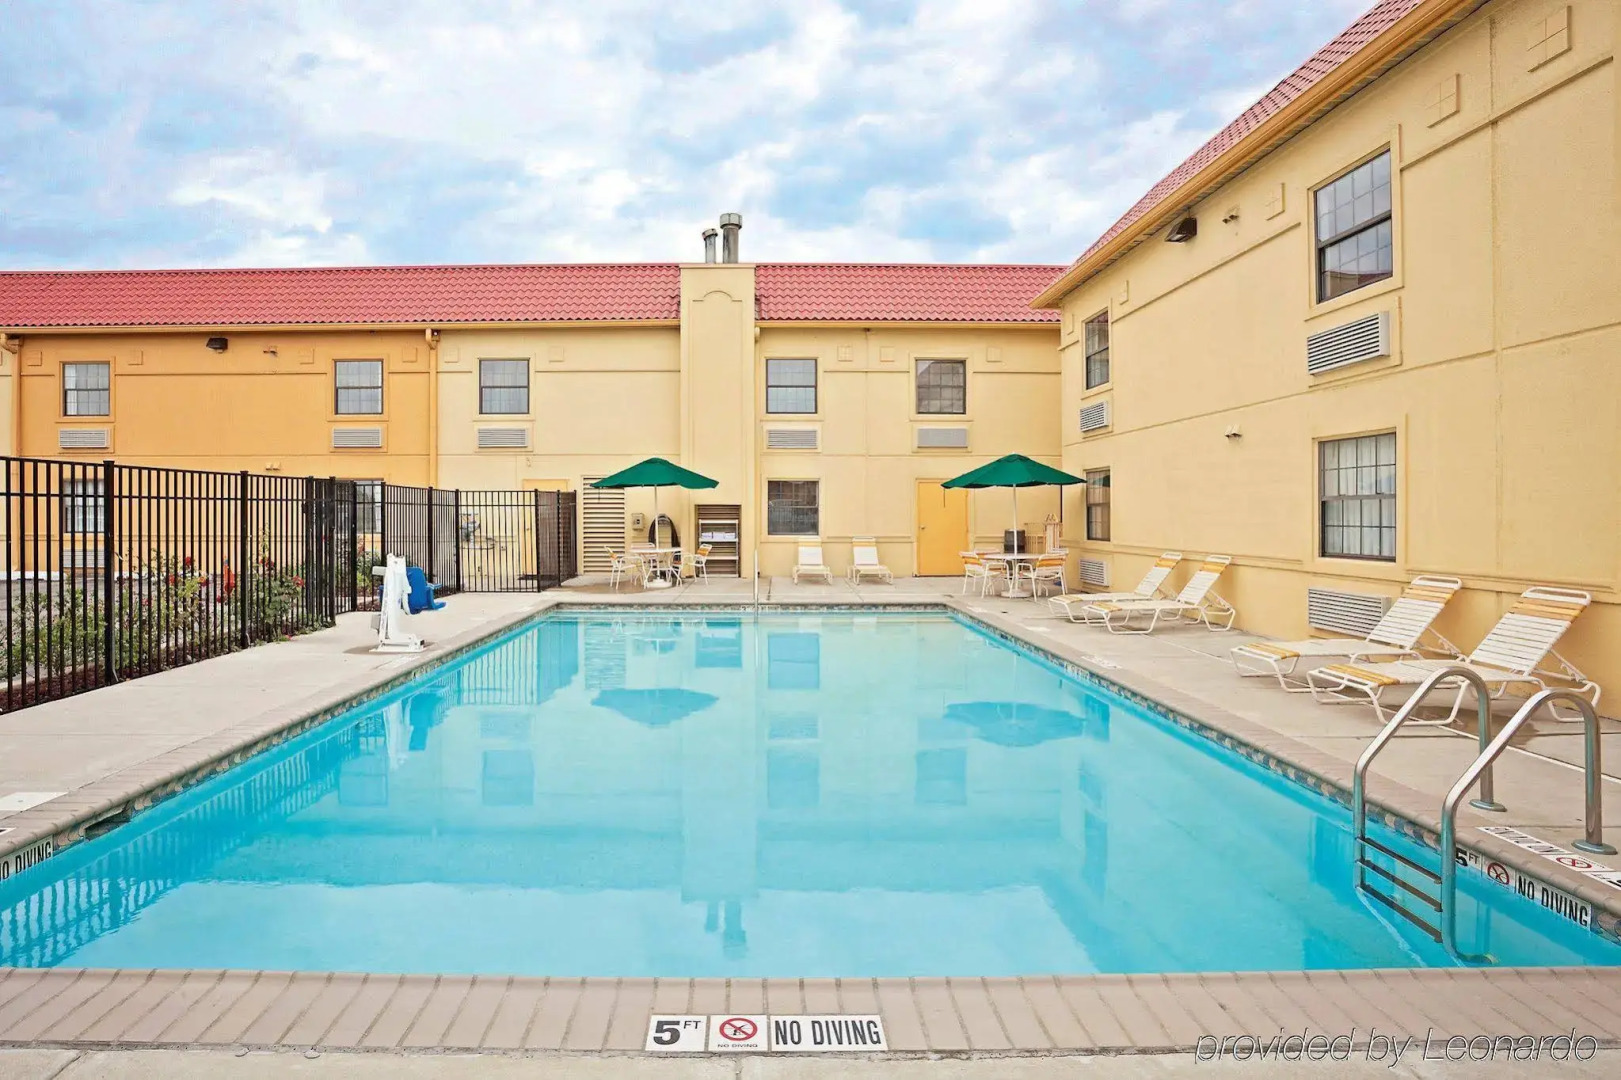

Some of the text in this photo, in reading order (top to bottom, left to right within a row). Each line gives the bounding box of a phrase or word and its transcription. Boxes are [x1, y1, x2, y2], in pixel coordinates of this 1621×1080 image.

[15, 841, 51, 874] DIVING
[1455, 847, 1478, 867] 5 FT
[1518, 875, 1588, 927] NO DIVING
[653, 1020, 701, 1046] 5 FT
[774, 1020, 881, 1045] NO DIVING
